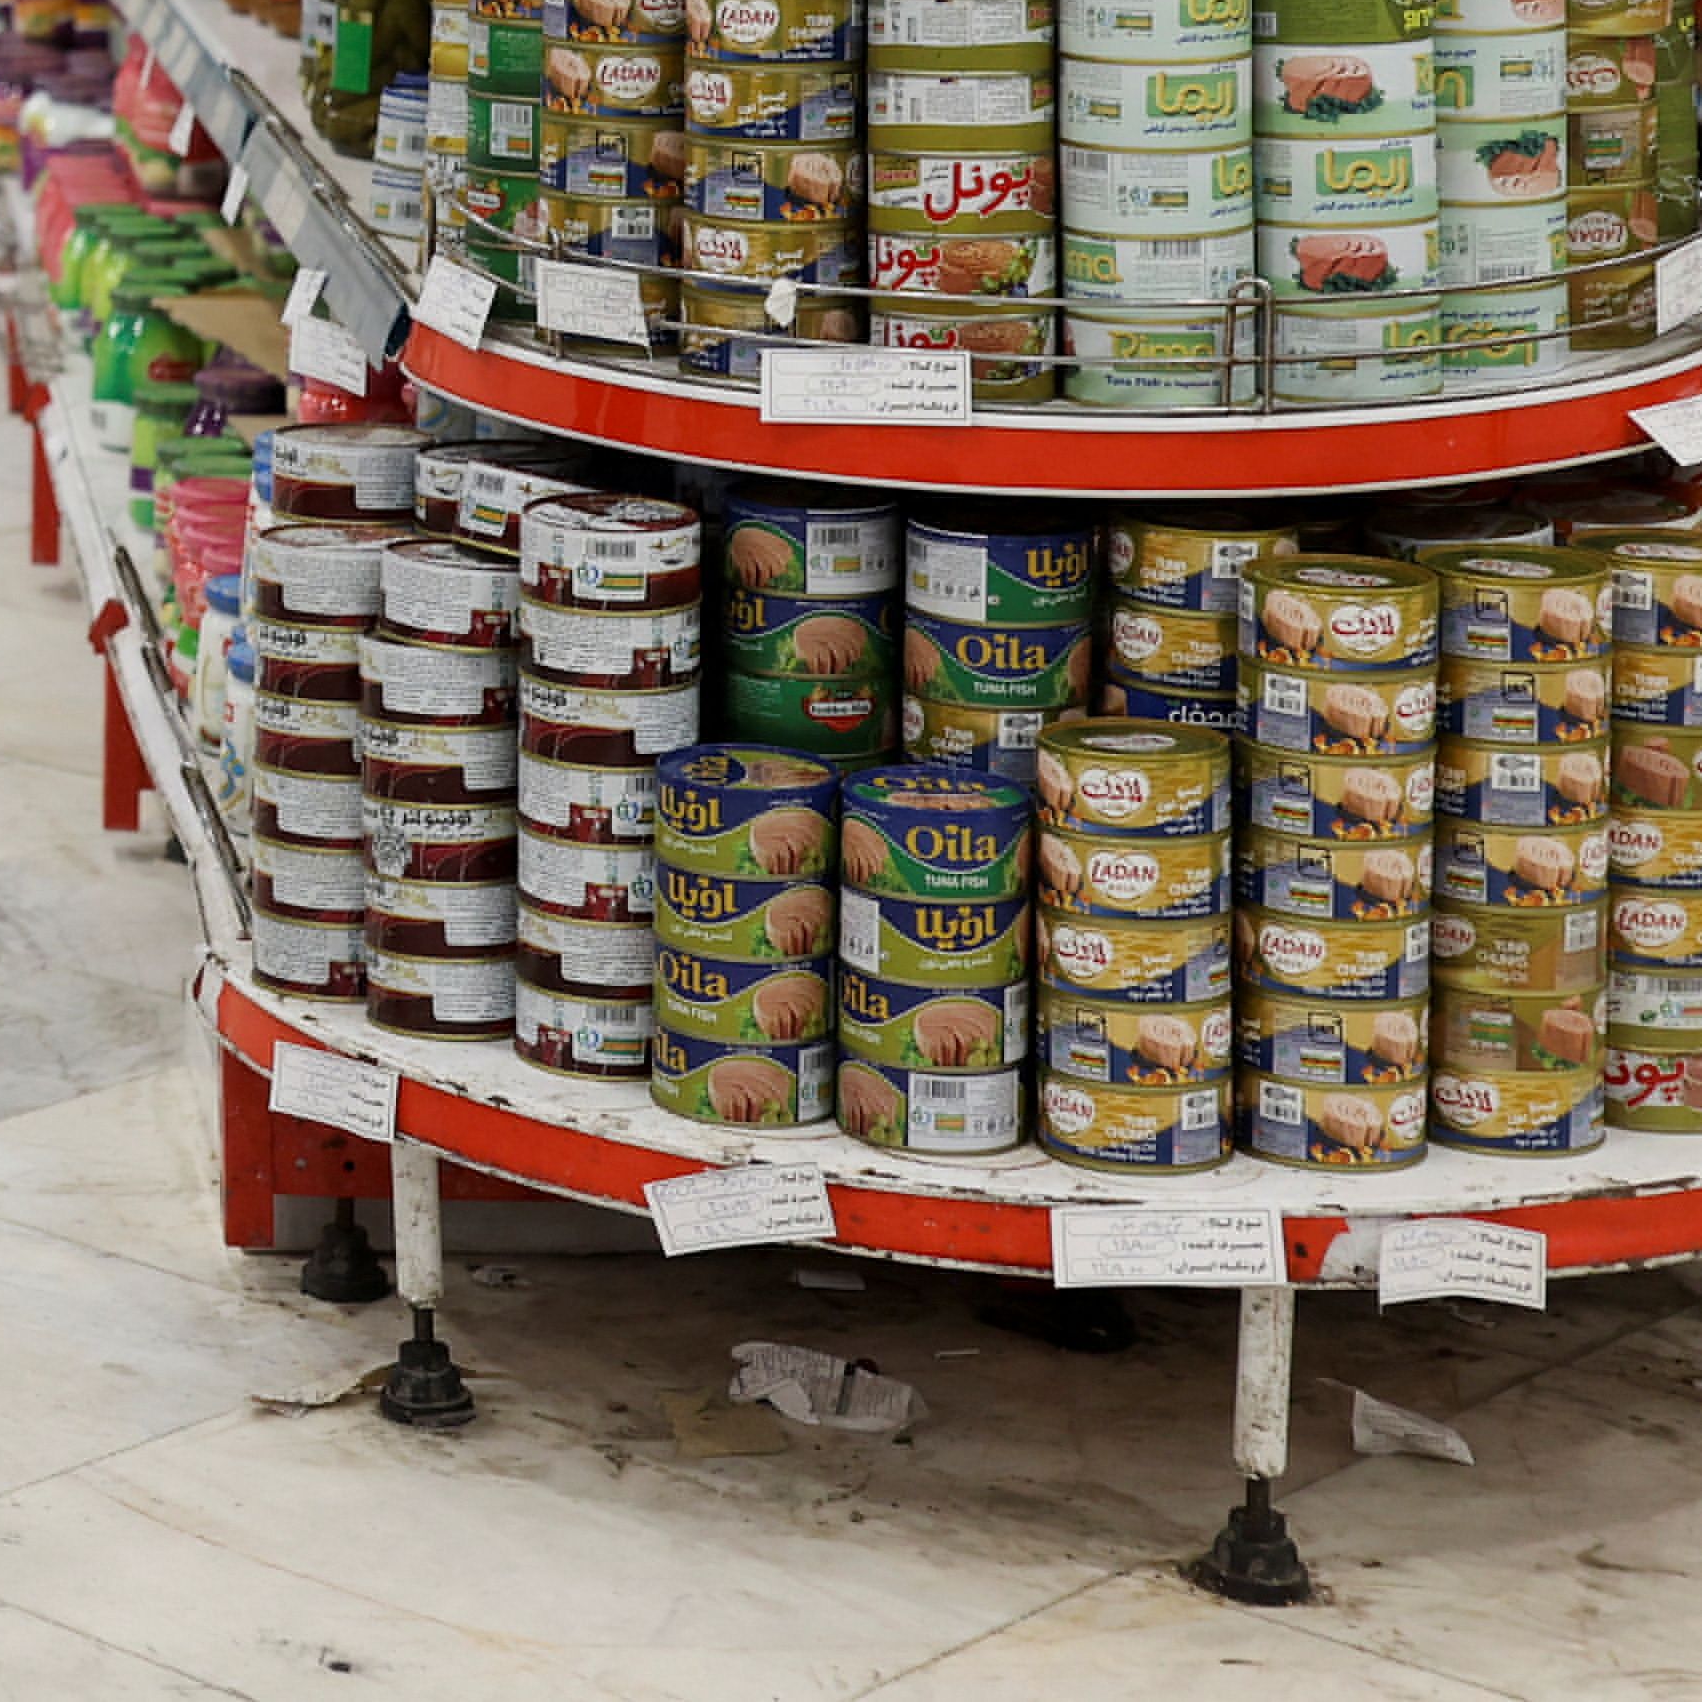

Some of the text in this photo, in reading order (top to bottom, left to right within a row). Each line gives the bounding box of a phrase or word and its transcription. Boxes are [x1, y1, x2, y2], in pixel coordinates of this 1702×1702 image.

[1153, 72, 1236, 117] ریما
[924, 161, 1036, 221] پونل
[1323, 146, 1408, 196] ریما
[956, 634, 1048, 670] Oila
[905, 825, 998, 862] Oila
[1091, 860, 1157, 884] LADAN
